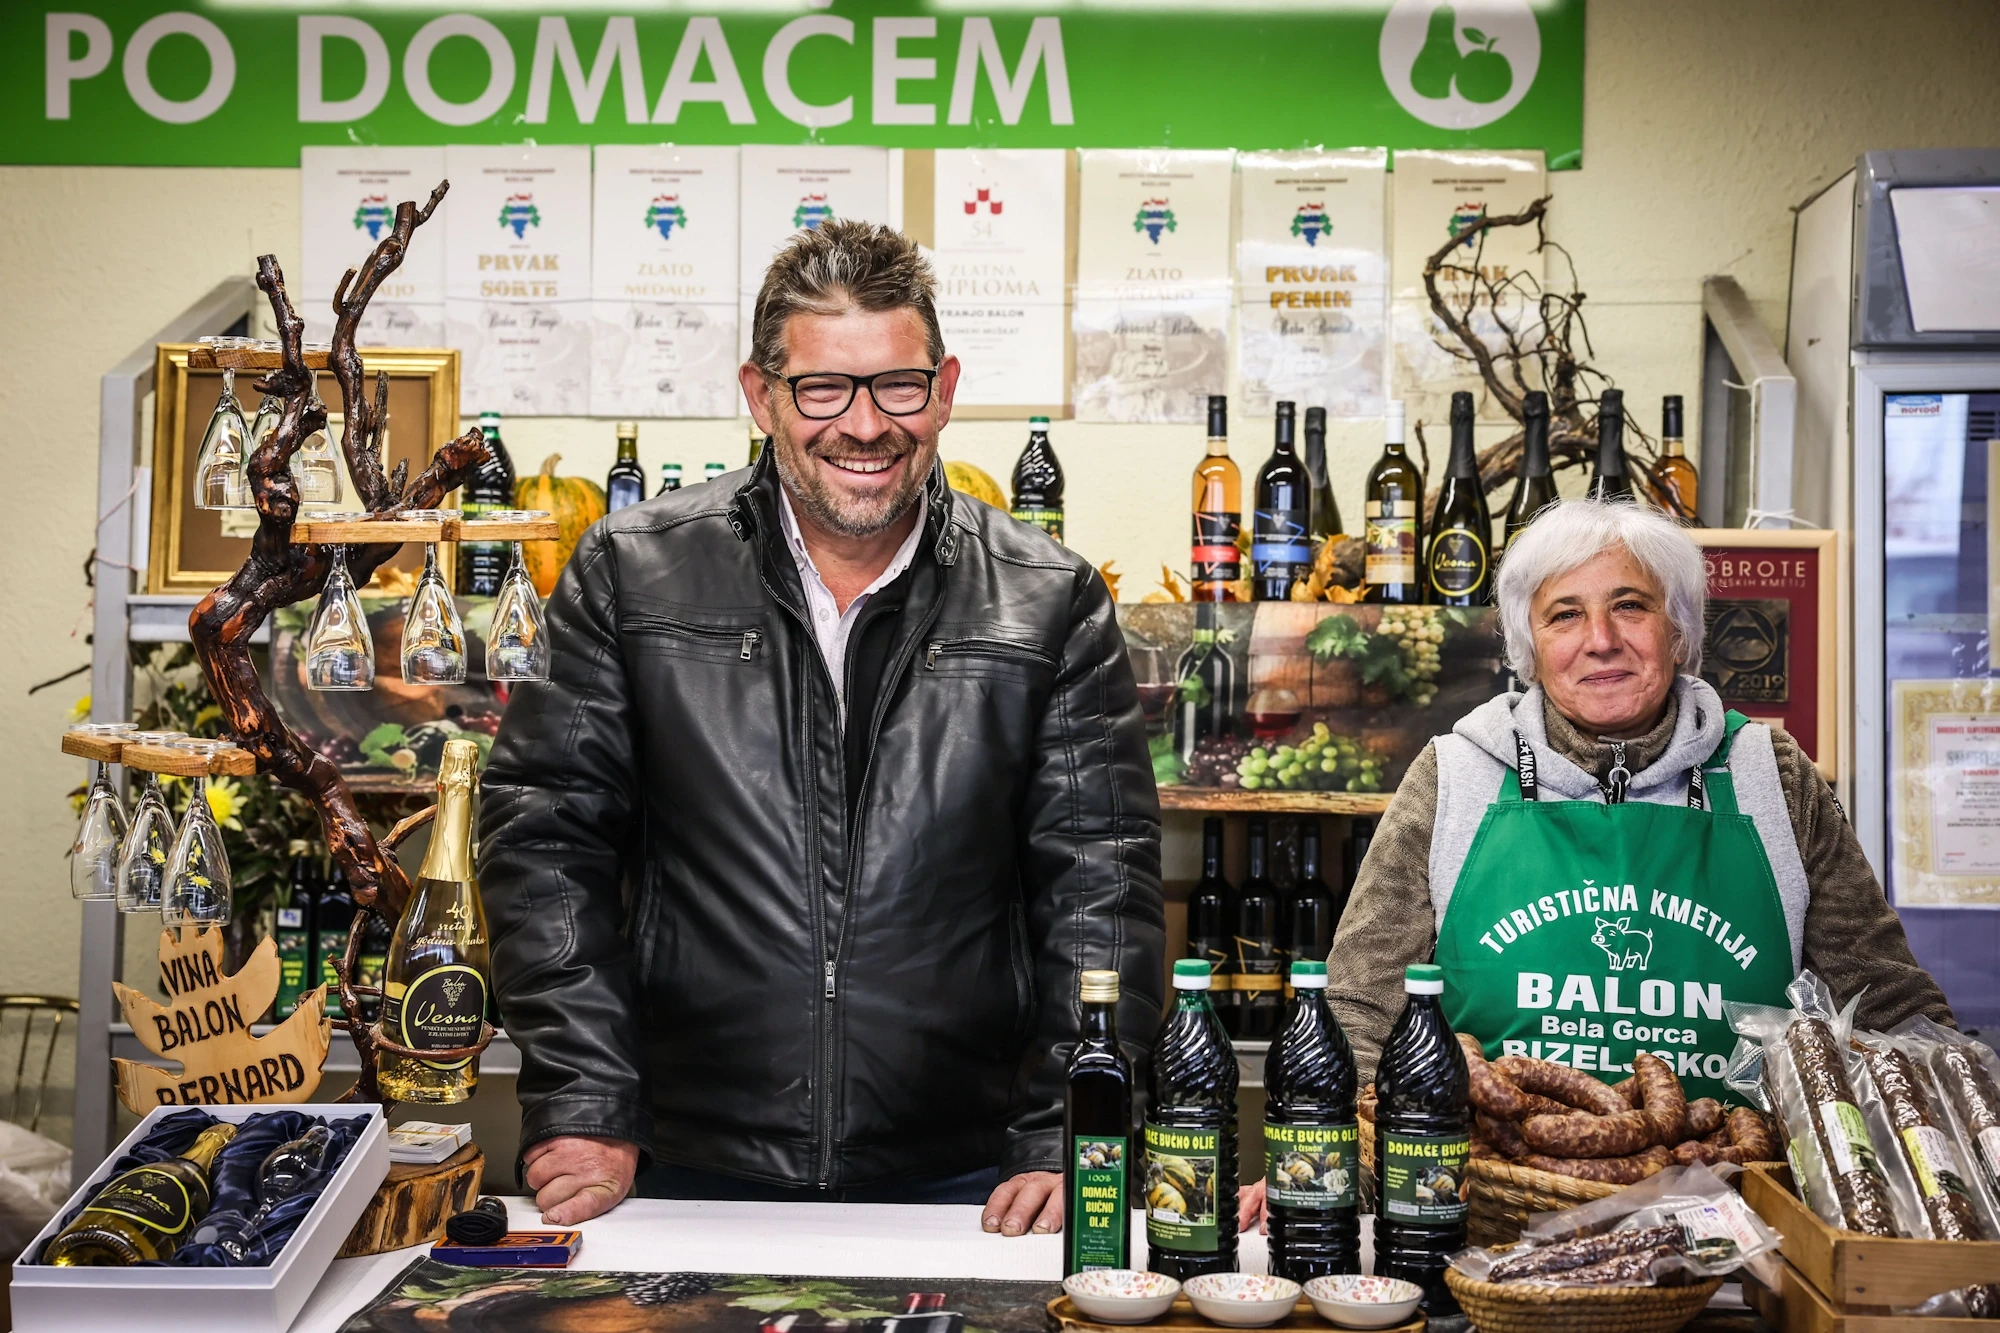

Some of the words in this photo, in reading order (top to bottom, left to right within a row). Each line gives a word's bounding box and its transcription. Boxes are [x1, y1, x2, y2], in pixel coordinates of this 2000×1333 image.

[45, 11, 236, 124] PO
[298, 0, 1075, 128] DOMAČEM
[478, 254, 560, 271] PRVAK
[637, 263, 694, 277] ZLATO
[949, 263, 1017, 277] ZLATNA
[1126, 268, 1183, 281] ZLATO
[480, 280, 559, 297] SORTE
[625, 284, 705, 298] MEDALJO
[1270, 291, 1353, 309] PENIN
[940, 309, 985, 318] FRANJO
[988, 309, 1025, 318] BALON
[1901, 405, 1941, 414] norcool
[1738, 673, 1785, 689] 2019
[446, 901, 471, 919] 40
[1479, 879, 1639, 955] TURISTIČNA
[1650, 888, 1759, 971] KMETIJA
[160, 950, 219, 996] VINA
[1517, 972, 1723, 1021] BALON
[414, 1000, 480, 1027] Vesna
[152, 993, 246, 1052] BALON
[1541, 1015, 1605, 1039] Bela
[1612, 1020, 1698, 1045] Gorca
[156, 1053, 305, 1105] BERNARD
[1159, 1132, 1188, 1149] BUČNO
[1192, 1135, 1214, 1150] OLJE
[1297, 1129, 1339, 1143] BUČNO
[1387, 1140, 1439, 1157] DOMAČE
[1088, 1174, 1112, 1182] 100%
[1082, 1185, 1118, 1199] DOMAČE
[1085, 1200, 1114, 1214] BUČNO
[1089, 1216, 1110, 1229] OLJE
